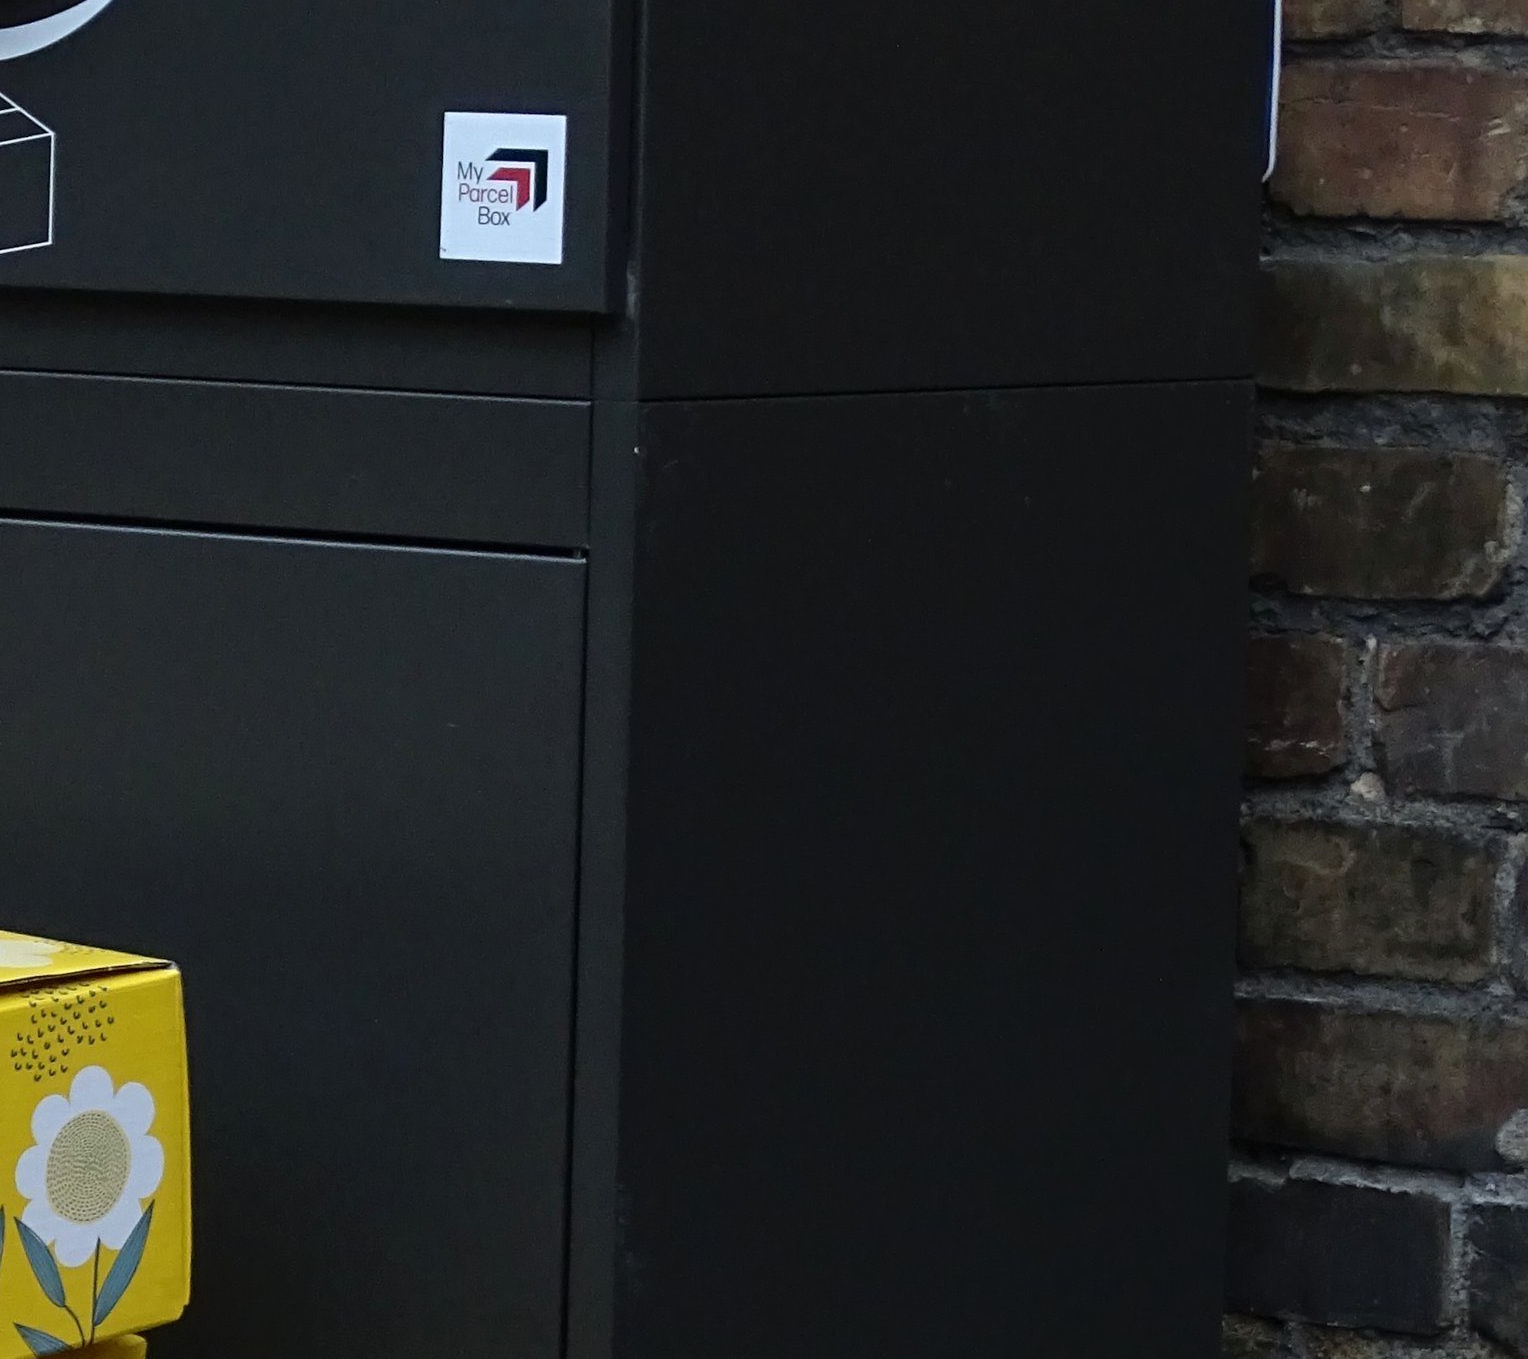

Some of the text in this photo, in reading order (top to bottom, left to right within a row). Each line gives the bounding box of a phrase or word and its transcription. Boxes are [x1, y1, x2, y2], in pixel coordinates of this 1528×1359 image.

[457, 161, 484, 184] My
[458, 183, 514, 204] Parcel
[477, 206, 511, 226] Box
